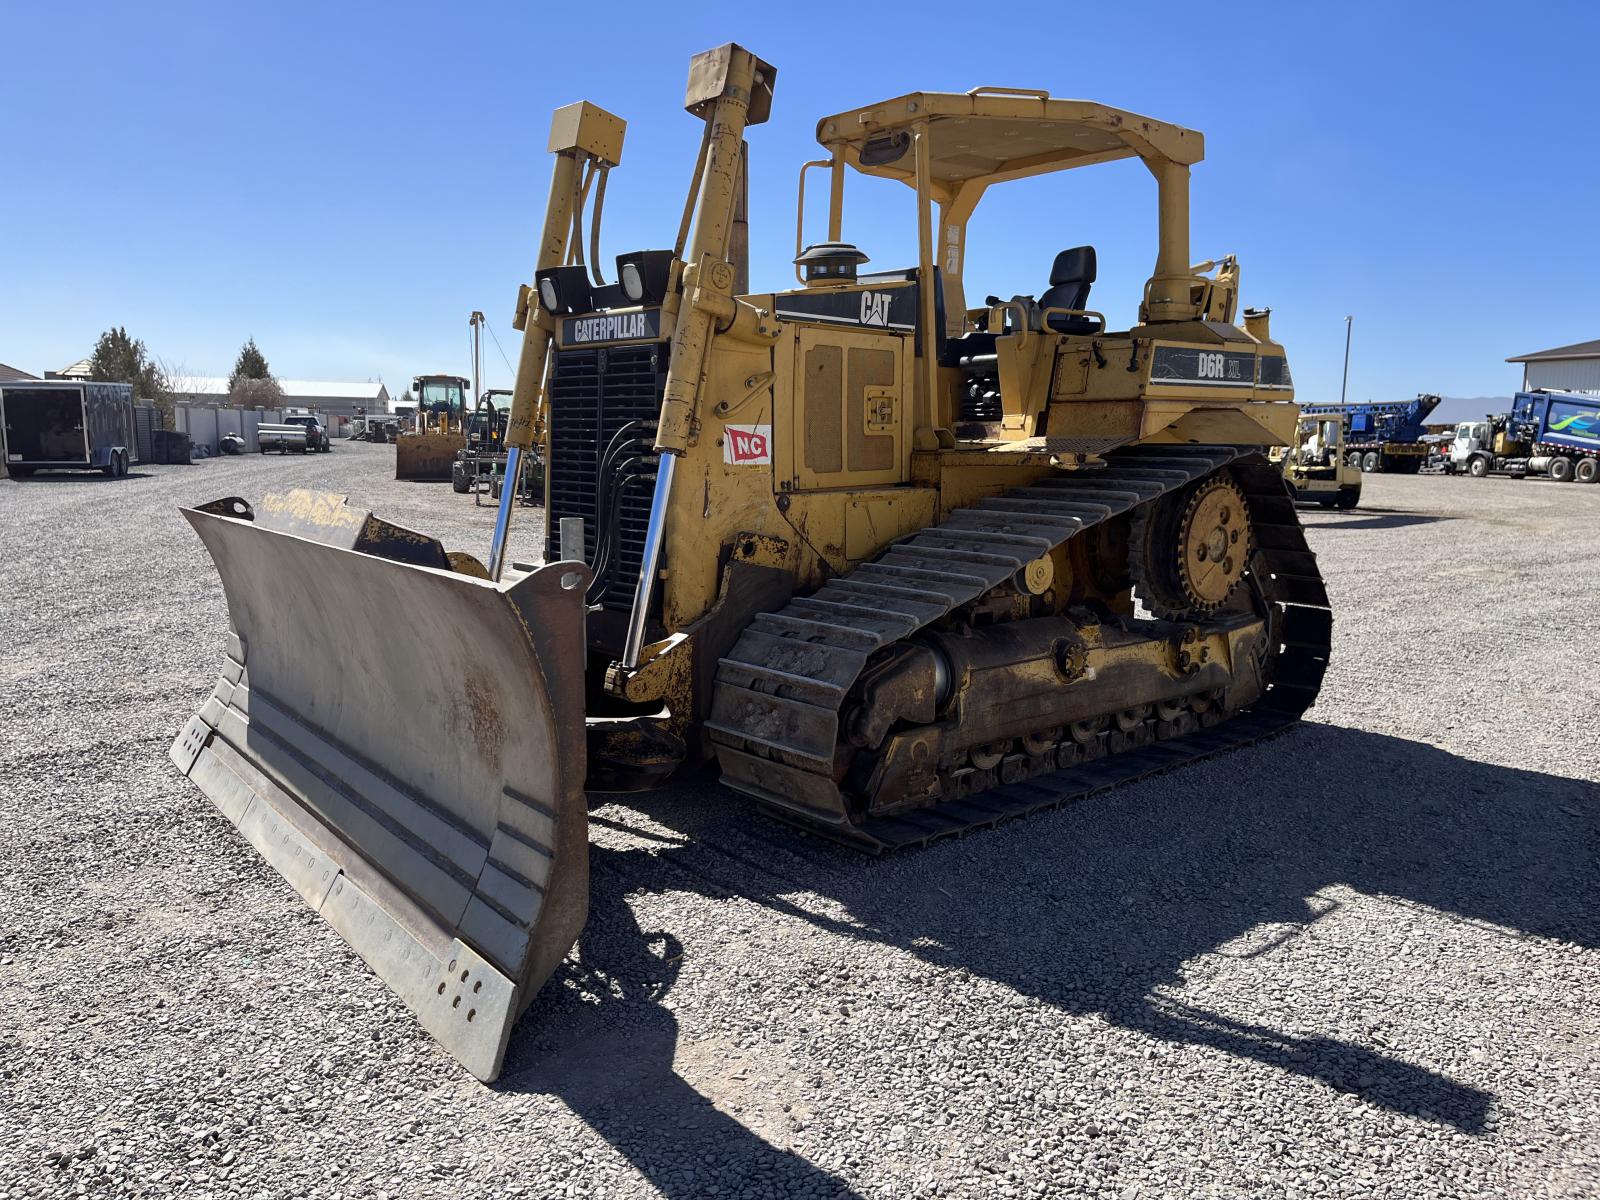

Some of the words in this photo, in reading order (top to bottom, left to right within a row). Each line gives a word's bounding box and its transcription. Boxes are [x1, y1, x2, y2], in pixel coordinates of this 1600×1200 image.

[860, 290, 892, 327] CAT
[574, 313, 645, 342] CATERPILLAR
[1198, 352, 1224, 378] D6R
[736, 436, 763, 455] NC
